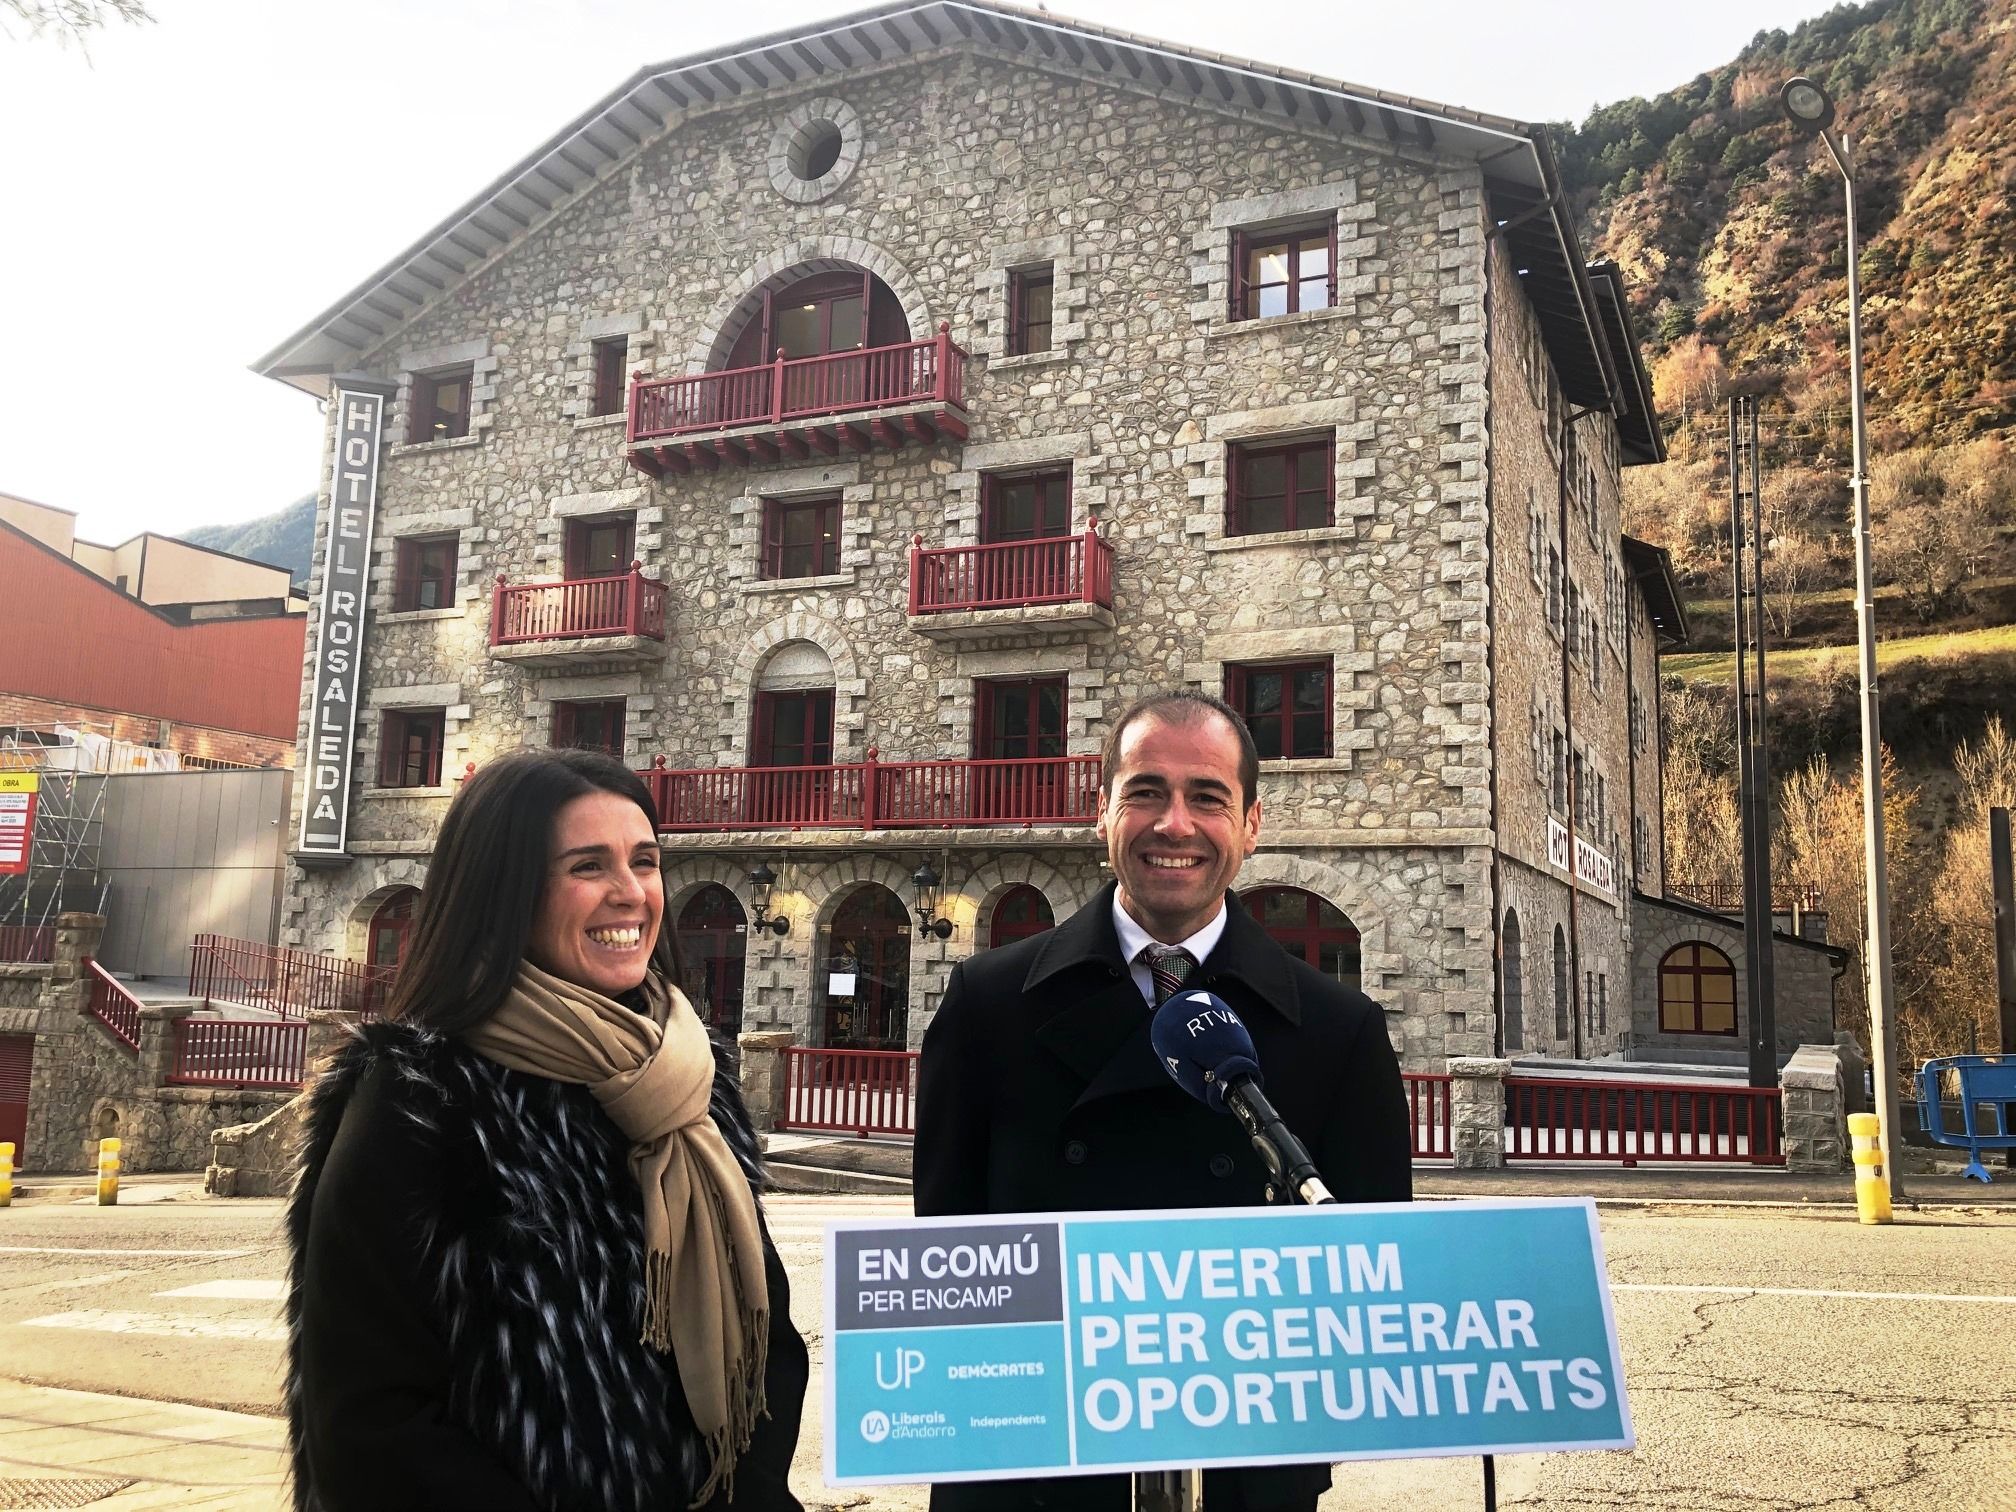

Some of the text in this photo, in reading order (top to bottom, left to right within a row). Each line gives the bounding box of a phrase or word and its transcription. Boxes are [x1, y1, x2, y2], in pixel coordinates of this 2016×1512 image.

[313, 401, 372, 820] HOTEL ROSALEDA
[2, 779, 20, 787] OBRA
[1186, 1010, 1243, 1037] RTVA
[858, 1233, 1039, 1281] EN COMÚ
[1077, 1242, 1403, 1303] INVERTIM
[858, 1285, 1012, 1312] PER ENCAMP
[1081, 1299, 1540, 1367] PER GENERAR
[875, 1347, 926, 1390] UP
[948, 1361, 1044, 1379] DEMÒCRATES
[1083, 1357, 1607, 1432] OPORTUNITATS
[892, 1411, 945, 1425] Liberals
[892, 1424, 956, 1439] d'Andorra
[970, 1414, 1046, 1429] Independents
